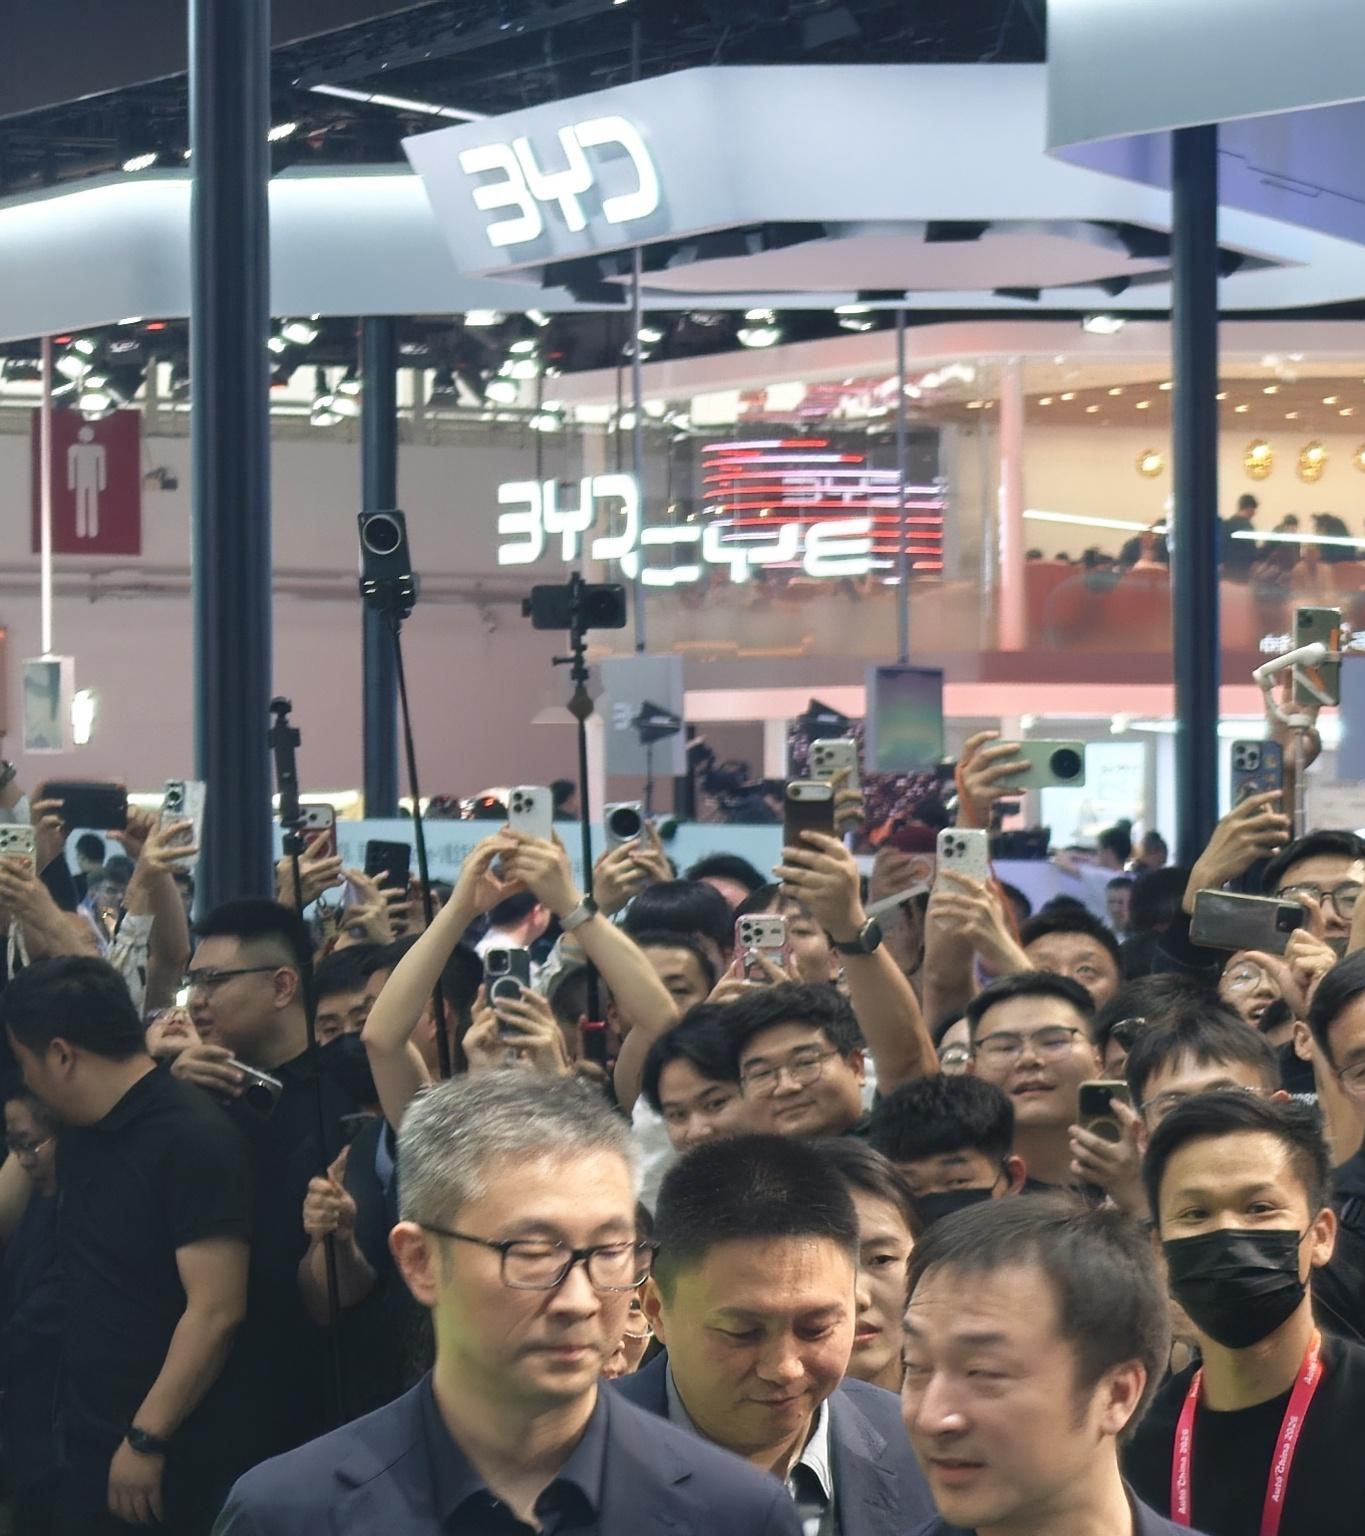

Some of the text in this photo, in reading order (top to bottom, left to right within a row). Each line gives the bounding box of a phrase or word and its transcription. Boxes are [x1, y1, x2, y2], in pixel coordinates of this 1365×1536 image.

[458, 115, 660, 247] BYD
[498, 474, 641, 564] BYD
[1177, 1456, 1187, 1488] China
[1178, 1489, 1187, 1514] Auto
[1272, 1415, 1299, 1502] Auto China 2026
